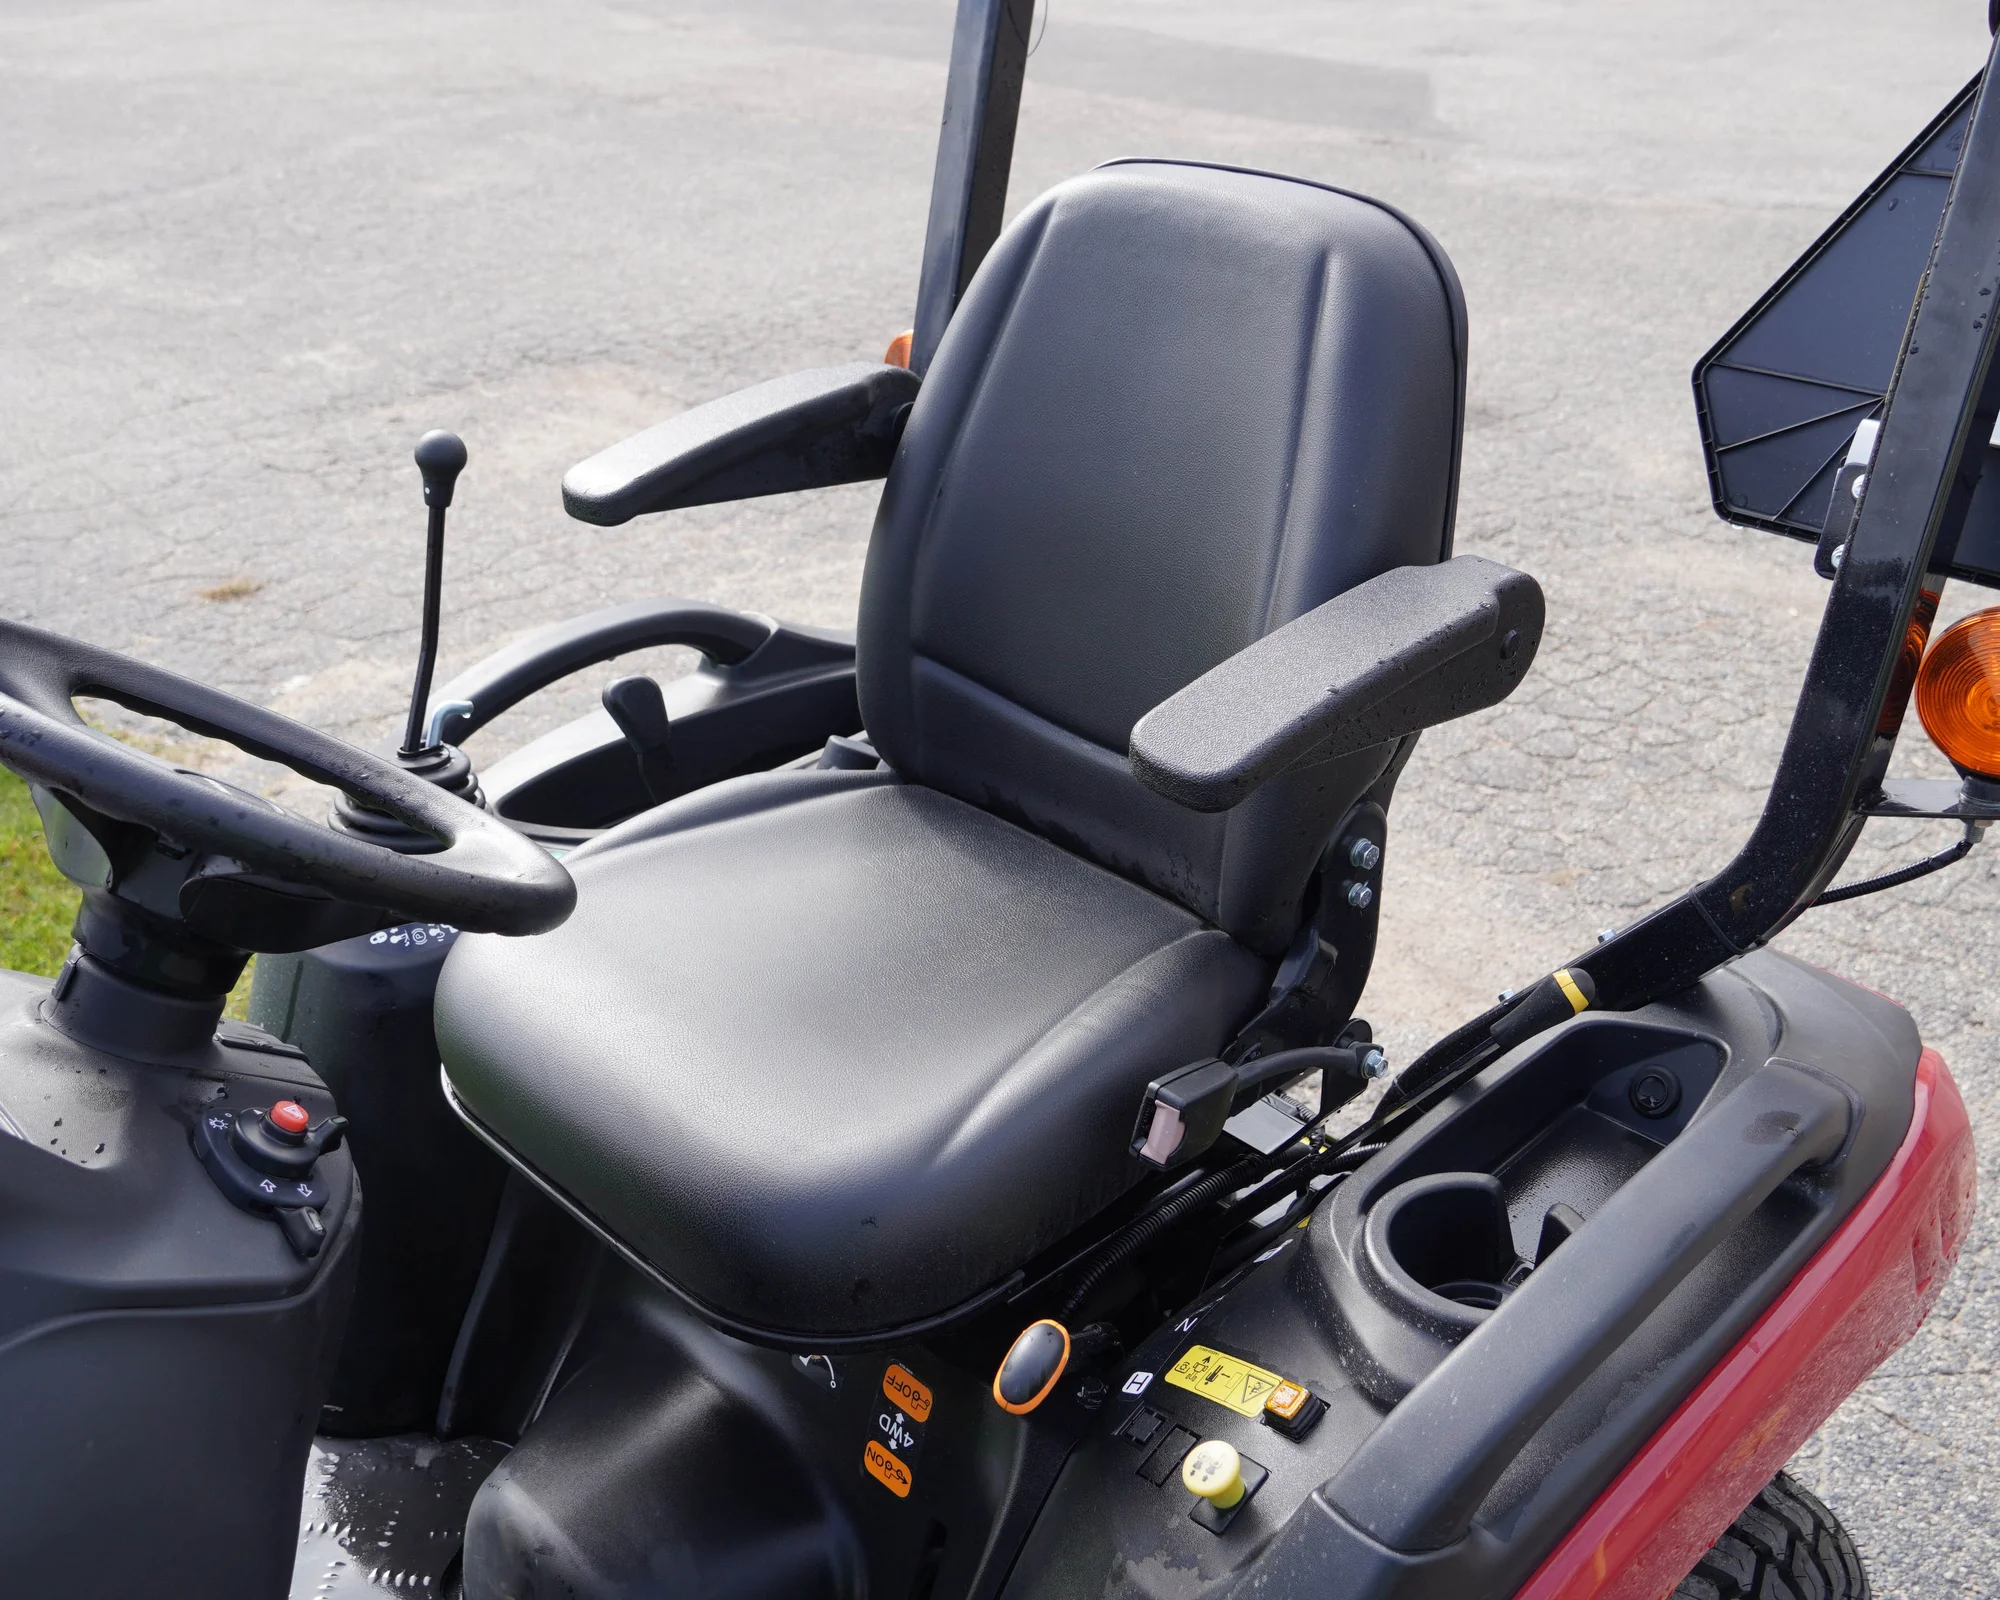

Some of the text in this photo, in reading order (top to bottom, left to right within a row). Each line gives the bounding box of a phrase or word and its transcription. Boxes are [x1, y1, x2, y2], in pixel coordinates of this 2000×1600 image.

[1174, 1317, 1198, 1332] N
[886, 1375, 911, 1398] OFF
[1126, 1373, 1149, 1392] H
[879, 1414, 914, 1447] 4WD
[867, 1446, 884, 1467] ON
